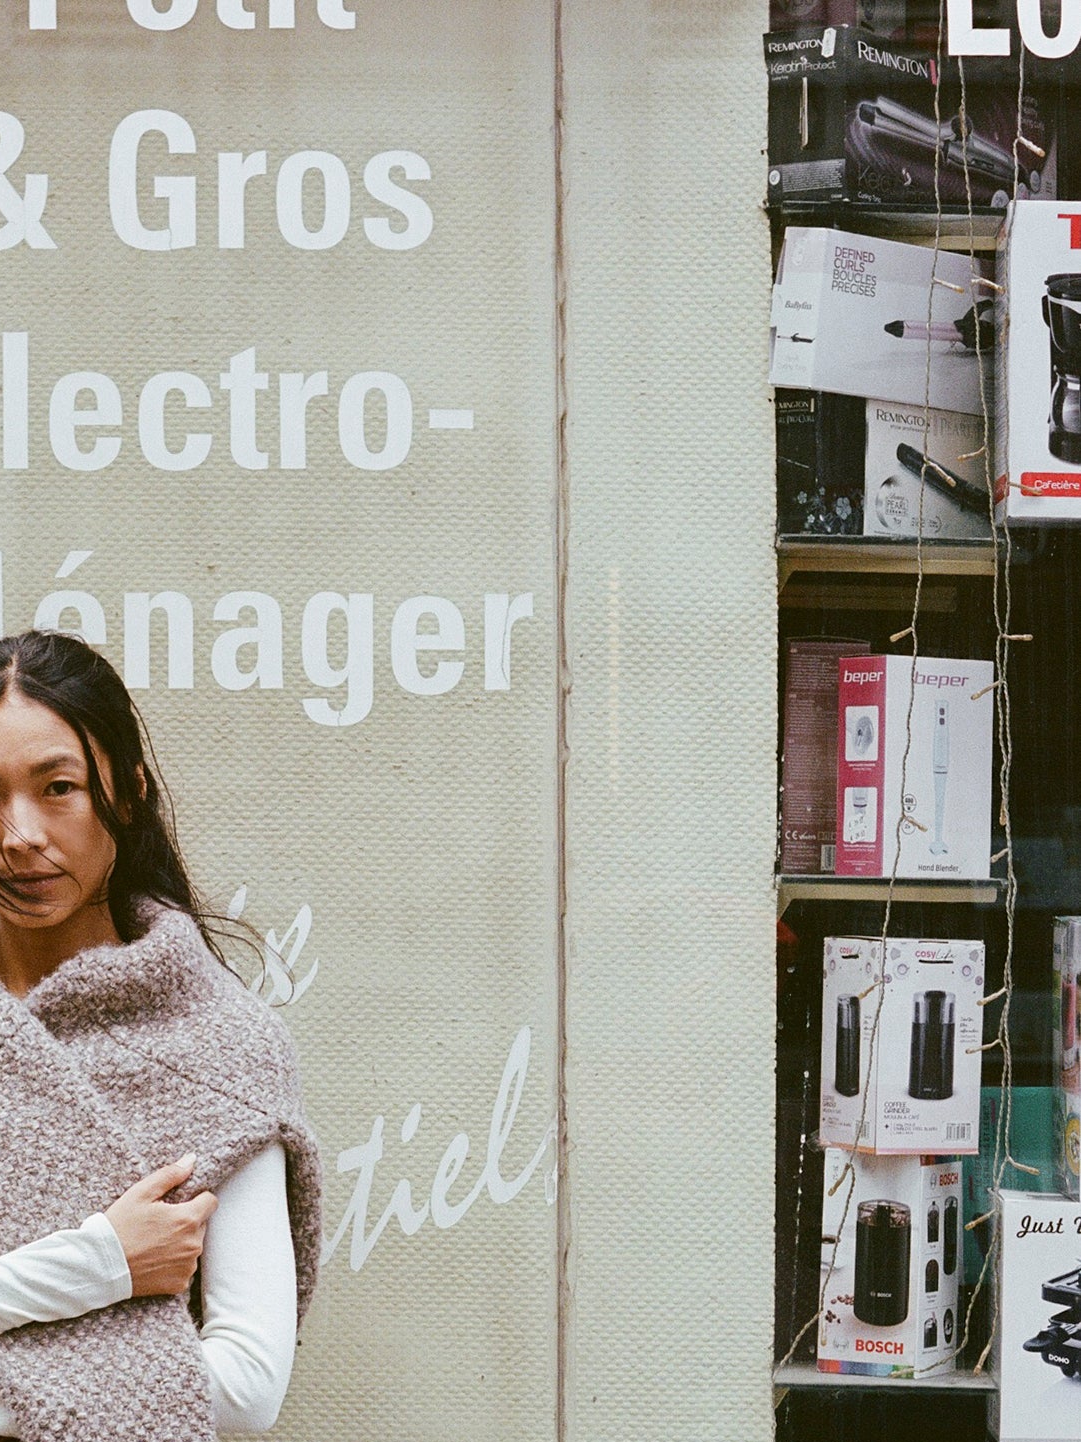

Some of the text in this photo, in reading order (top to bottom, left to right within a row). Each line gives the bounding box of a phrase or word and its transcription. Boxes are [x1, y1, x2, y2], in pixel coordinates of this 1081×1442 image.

[768, 39, 824, 54] REMINGTON
[857, 41, 929, 79] REMINGTON
[108, 109, 435, 252] Gros
[834, 246, 876, 264] DEFINED
[833, 258, 865, 273] CURLS
[832, 269, 877, 287] BOUCLES
[831, 280, 876, 298] PRECISES
[778, 401, 809, 409] MINGTON
[1034, 479, 1081, 491] Cafetière
[843, 669, 884, 686] beper
[914, 671, 969, 689] beper
[935, 864, 959, 872] Blender
[939, 1173, 959, 1187] BOSCH
[1016, 1215, 1064, 1238] Just
[855, 1339, 904, 1355] BOSCH
[1048, 1353, 1070, 1365] DOMO
